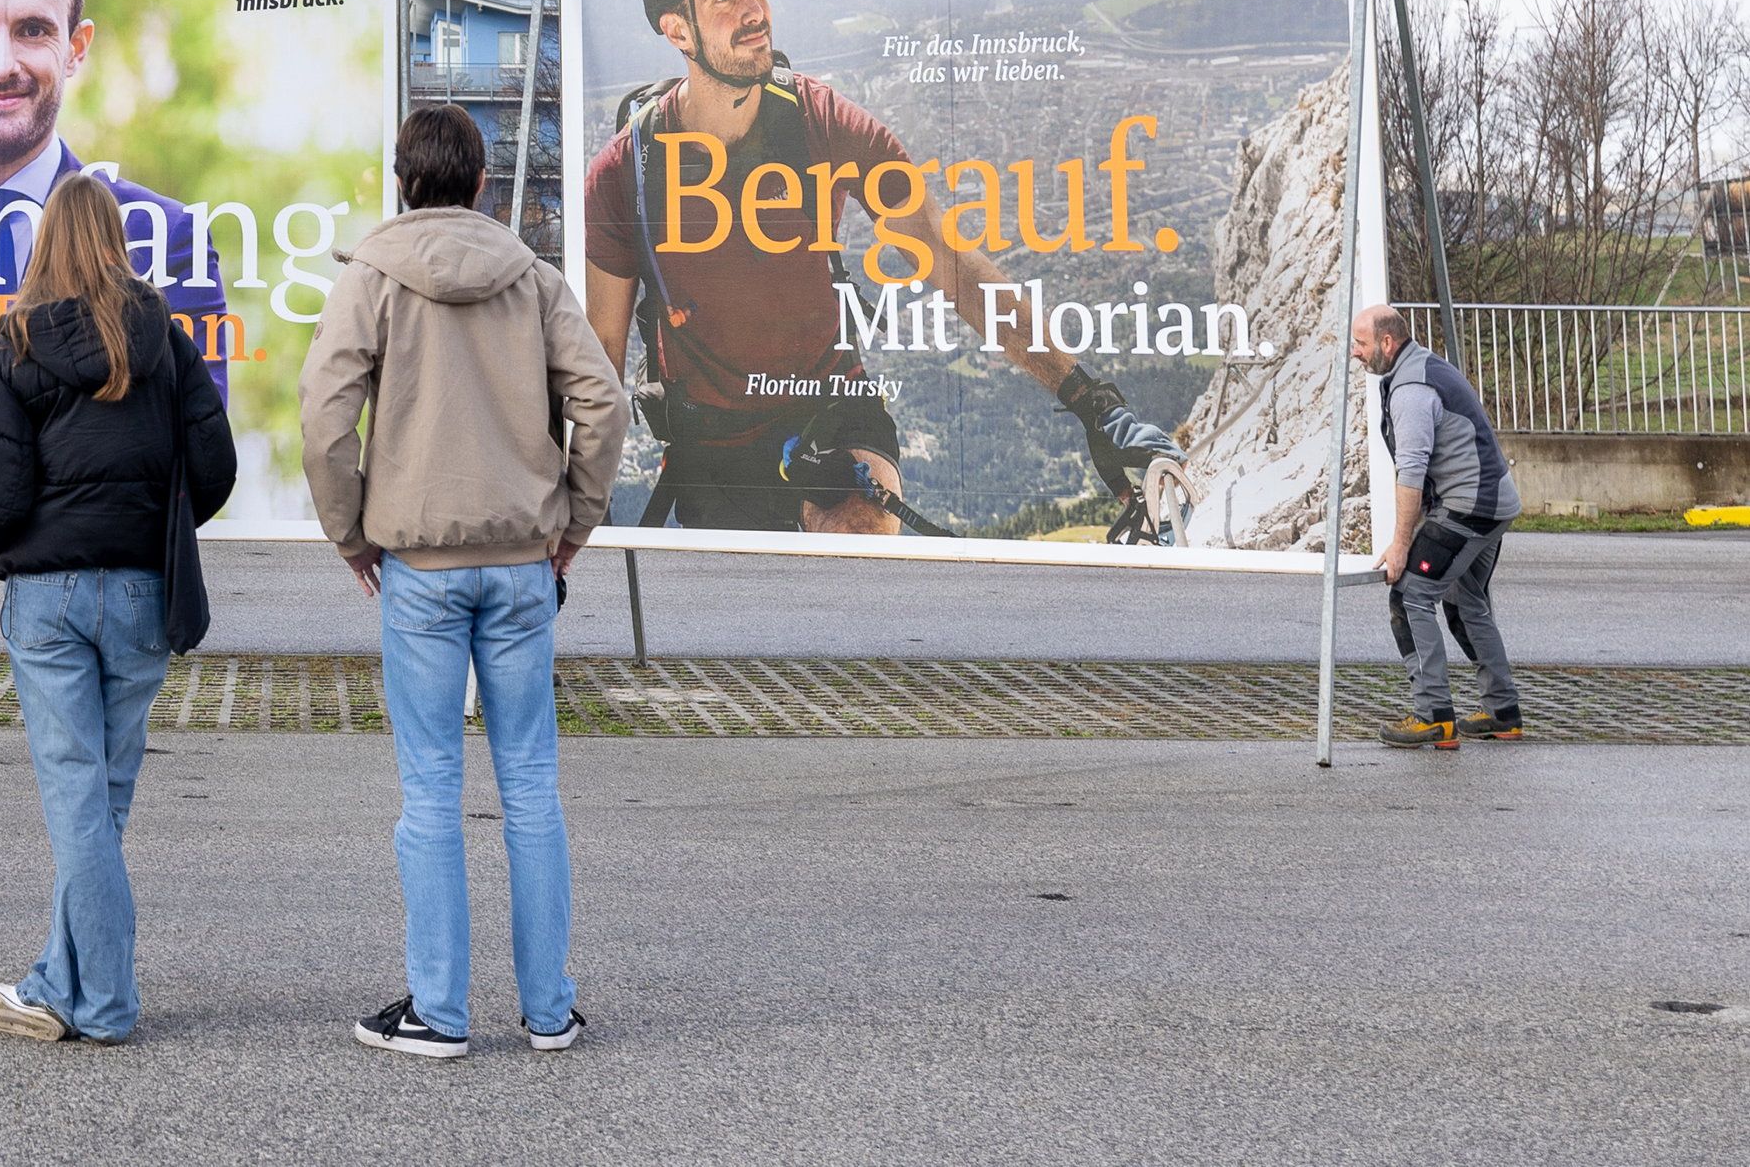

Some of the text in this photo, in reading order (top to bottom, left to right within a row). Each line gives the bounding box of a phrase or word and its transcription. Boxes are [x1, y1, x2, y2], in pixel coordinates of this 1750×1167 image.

[882, 30, 1086, 57] Für das Innsbruck,
[909, 58, 1066, 83] das wir lieben.
[653, 115, 1179, 286] Bergauf.
[832, 278, 1275, 358] Mit Florian.
[745, 373, 903, 402] Florian Tursky
